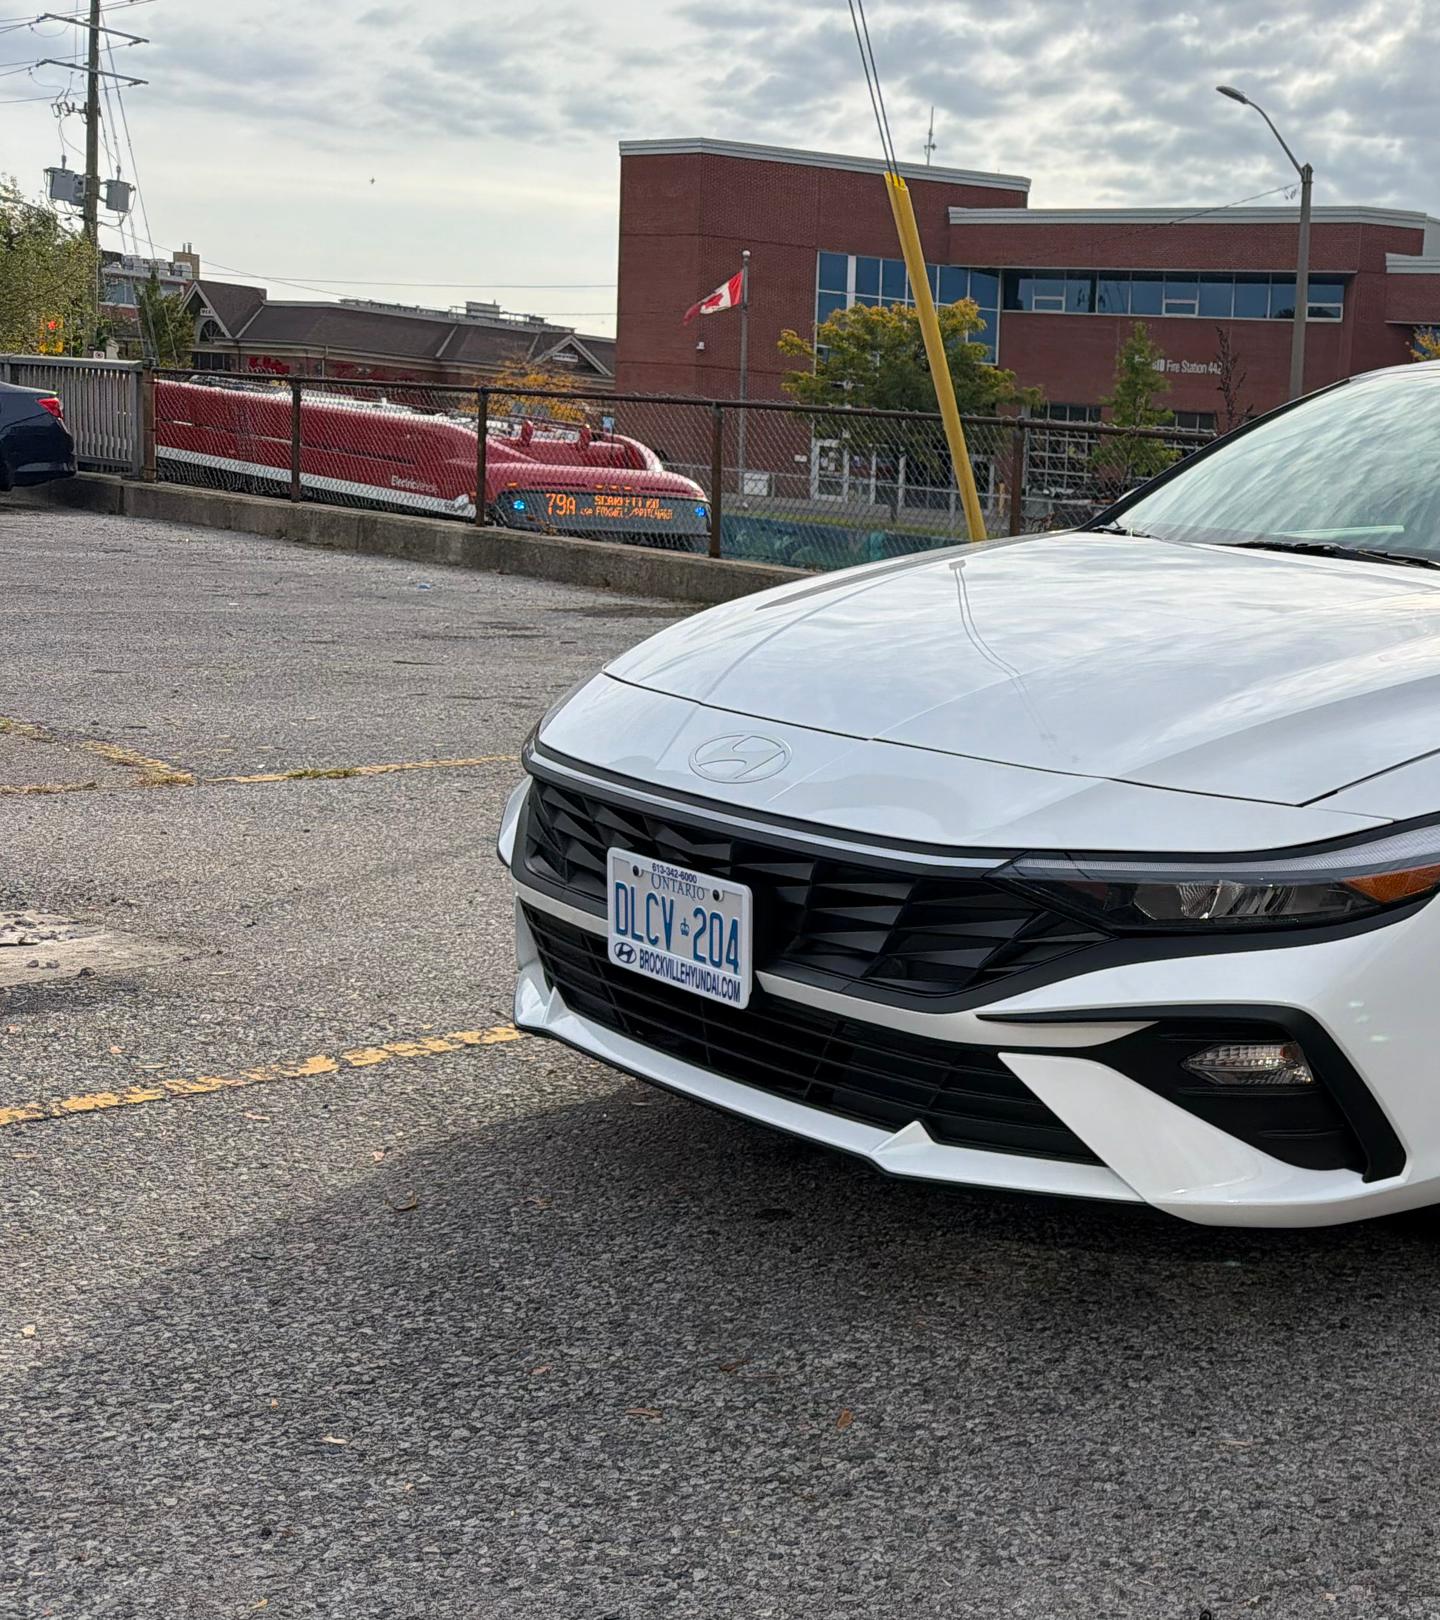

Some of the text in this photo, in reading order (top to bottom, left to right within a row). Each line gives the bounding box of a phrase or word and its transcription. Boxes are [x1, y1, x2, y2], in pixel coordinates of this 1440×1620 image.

[1167, 360, 1180, 373] Fire
[1181, 360, 1207, 374] Station
[545, 493, 577, 516] 79A
[652, 863, 697, 884] 613-342-6000
[651, 873, 705, 901] ONTARIO
[615, 882, 739, 975] DLCV 204
[639, 948, 741, 1003] BROCKVILLEHYUNDAI.COM
